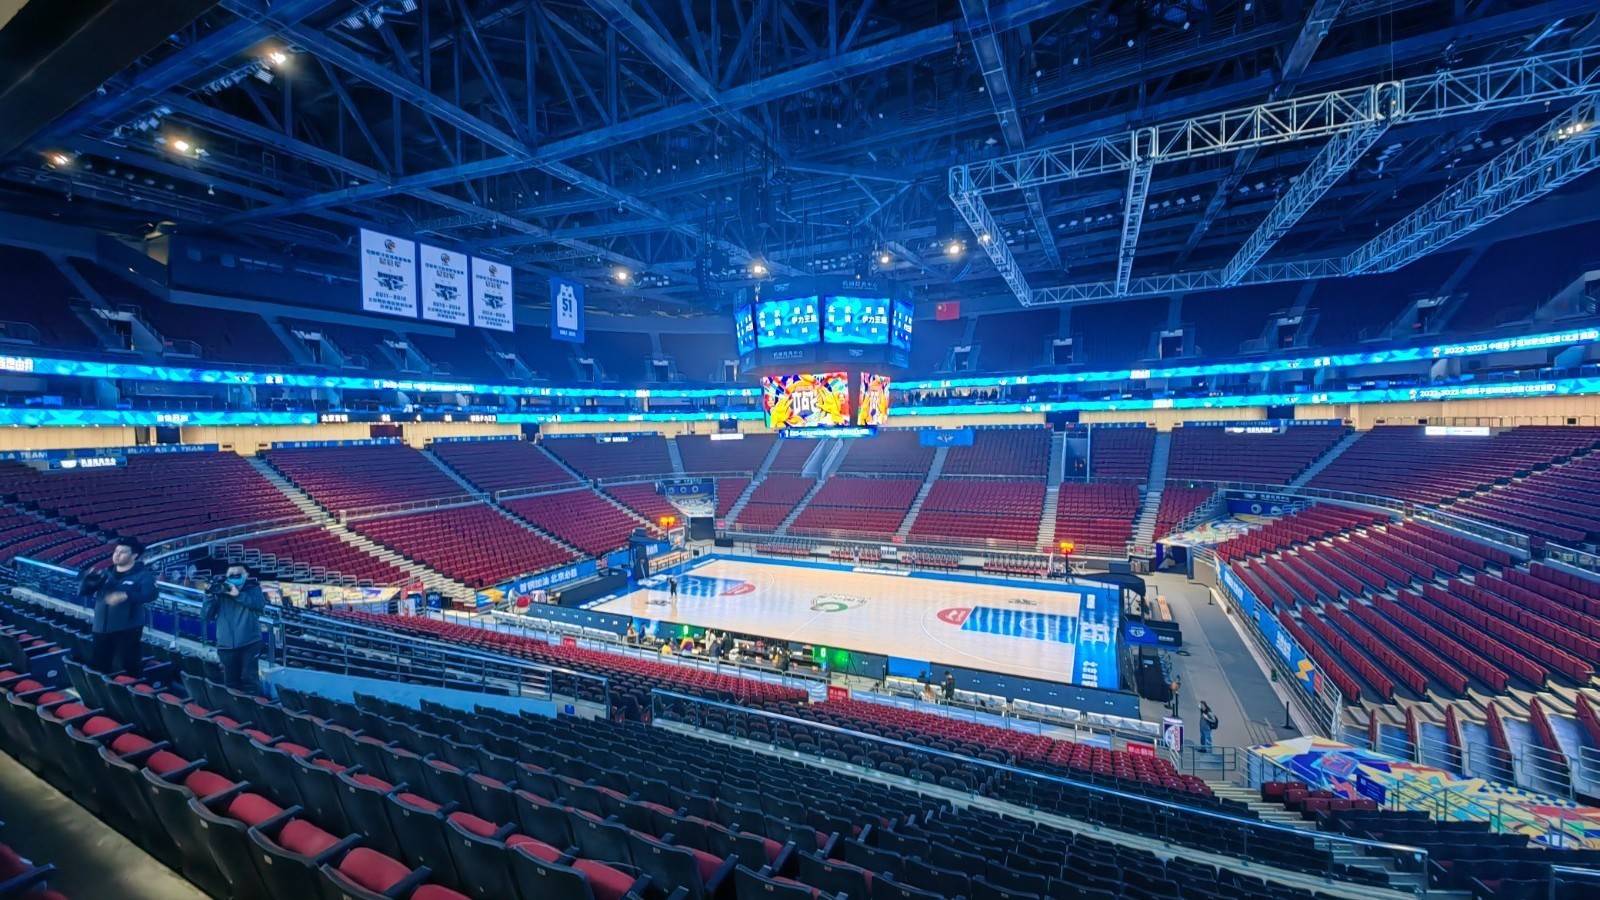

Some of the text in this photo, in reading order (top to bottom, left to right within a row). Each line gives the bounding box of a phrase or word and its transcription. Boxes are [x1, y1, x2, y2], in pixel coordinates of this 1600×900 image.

[562, 297, 573, 313] 51
[1444, 344, 1488, 354] 2022-2023
[1420, 388, 1459, 398] 2022-2023
